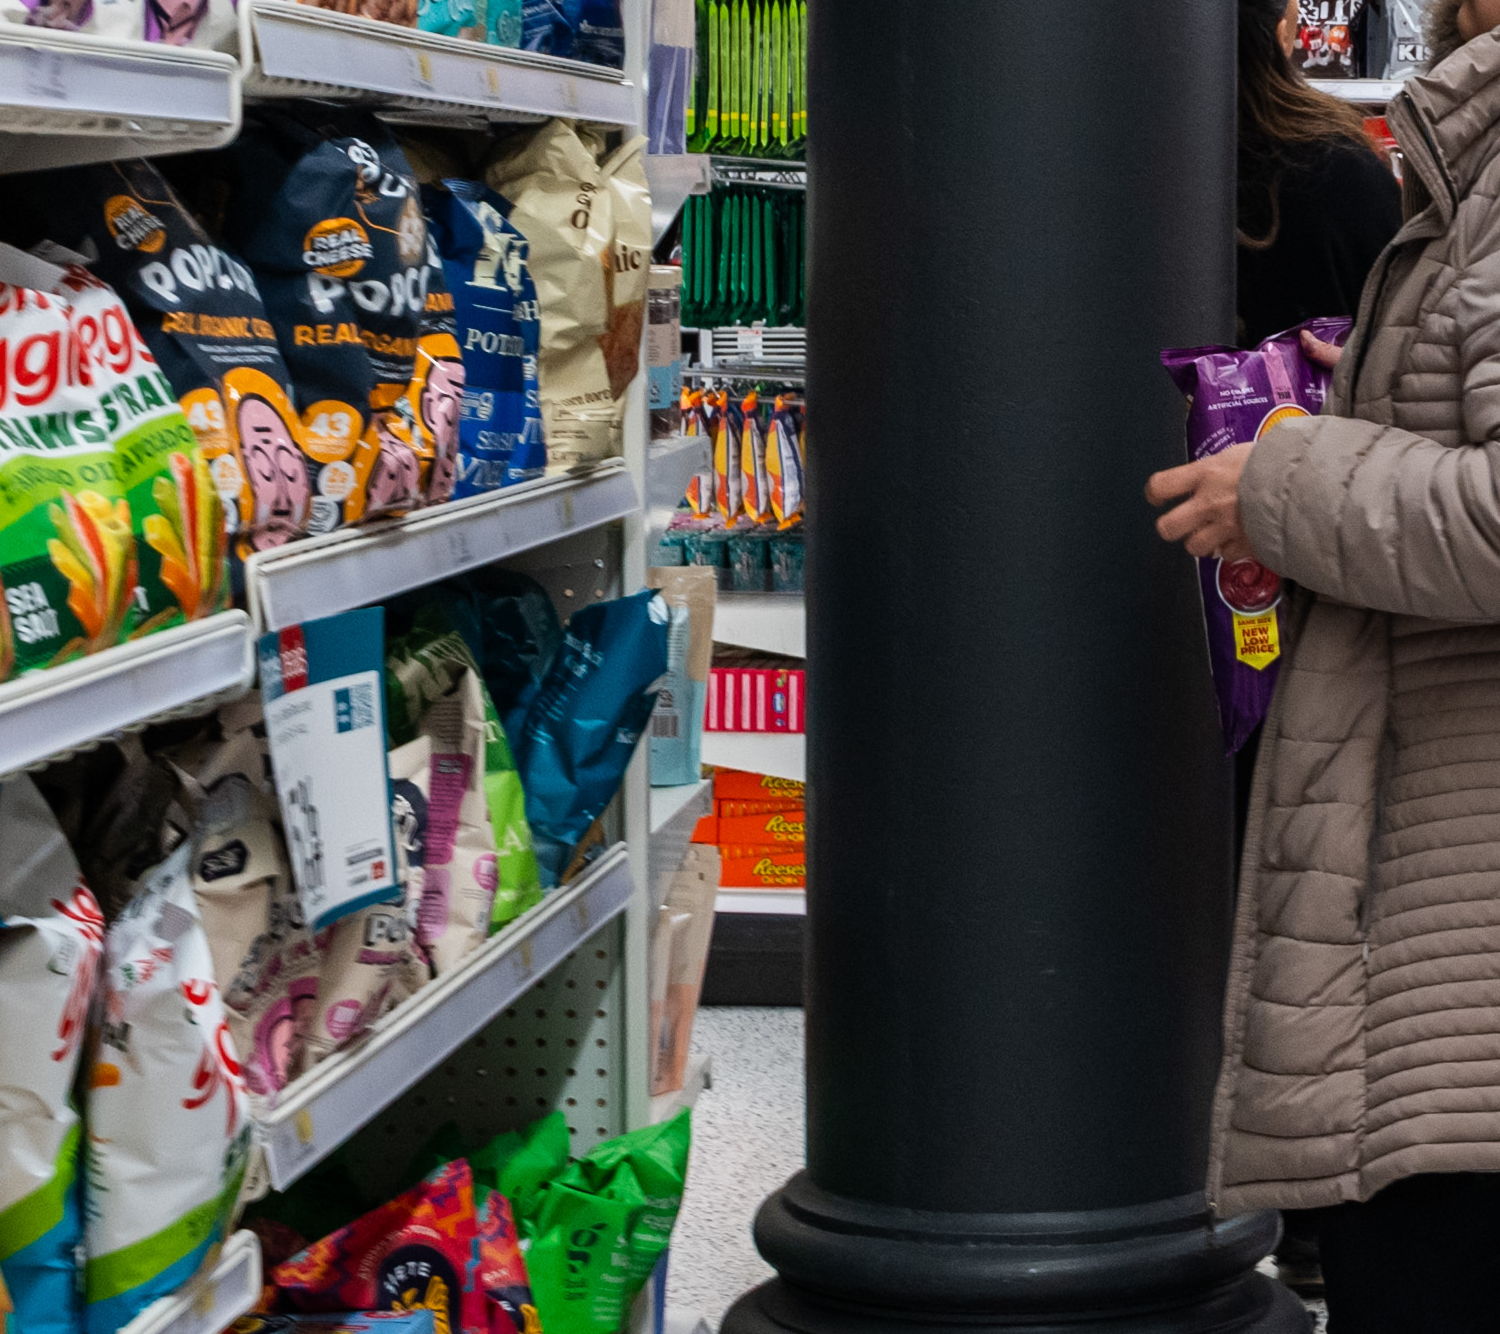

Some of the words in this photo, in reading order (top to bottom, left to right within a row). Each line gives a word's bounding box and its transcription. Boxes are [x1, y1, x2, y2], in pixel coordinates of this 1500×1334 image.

[1243, 628, 1269, 637] NEW
[1244, 637, 1269, 645] LOW
[1240, 645, 1274, 655] PRICE
